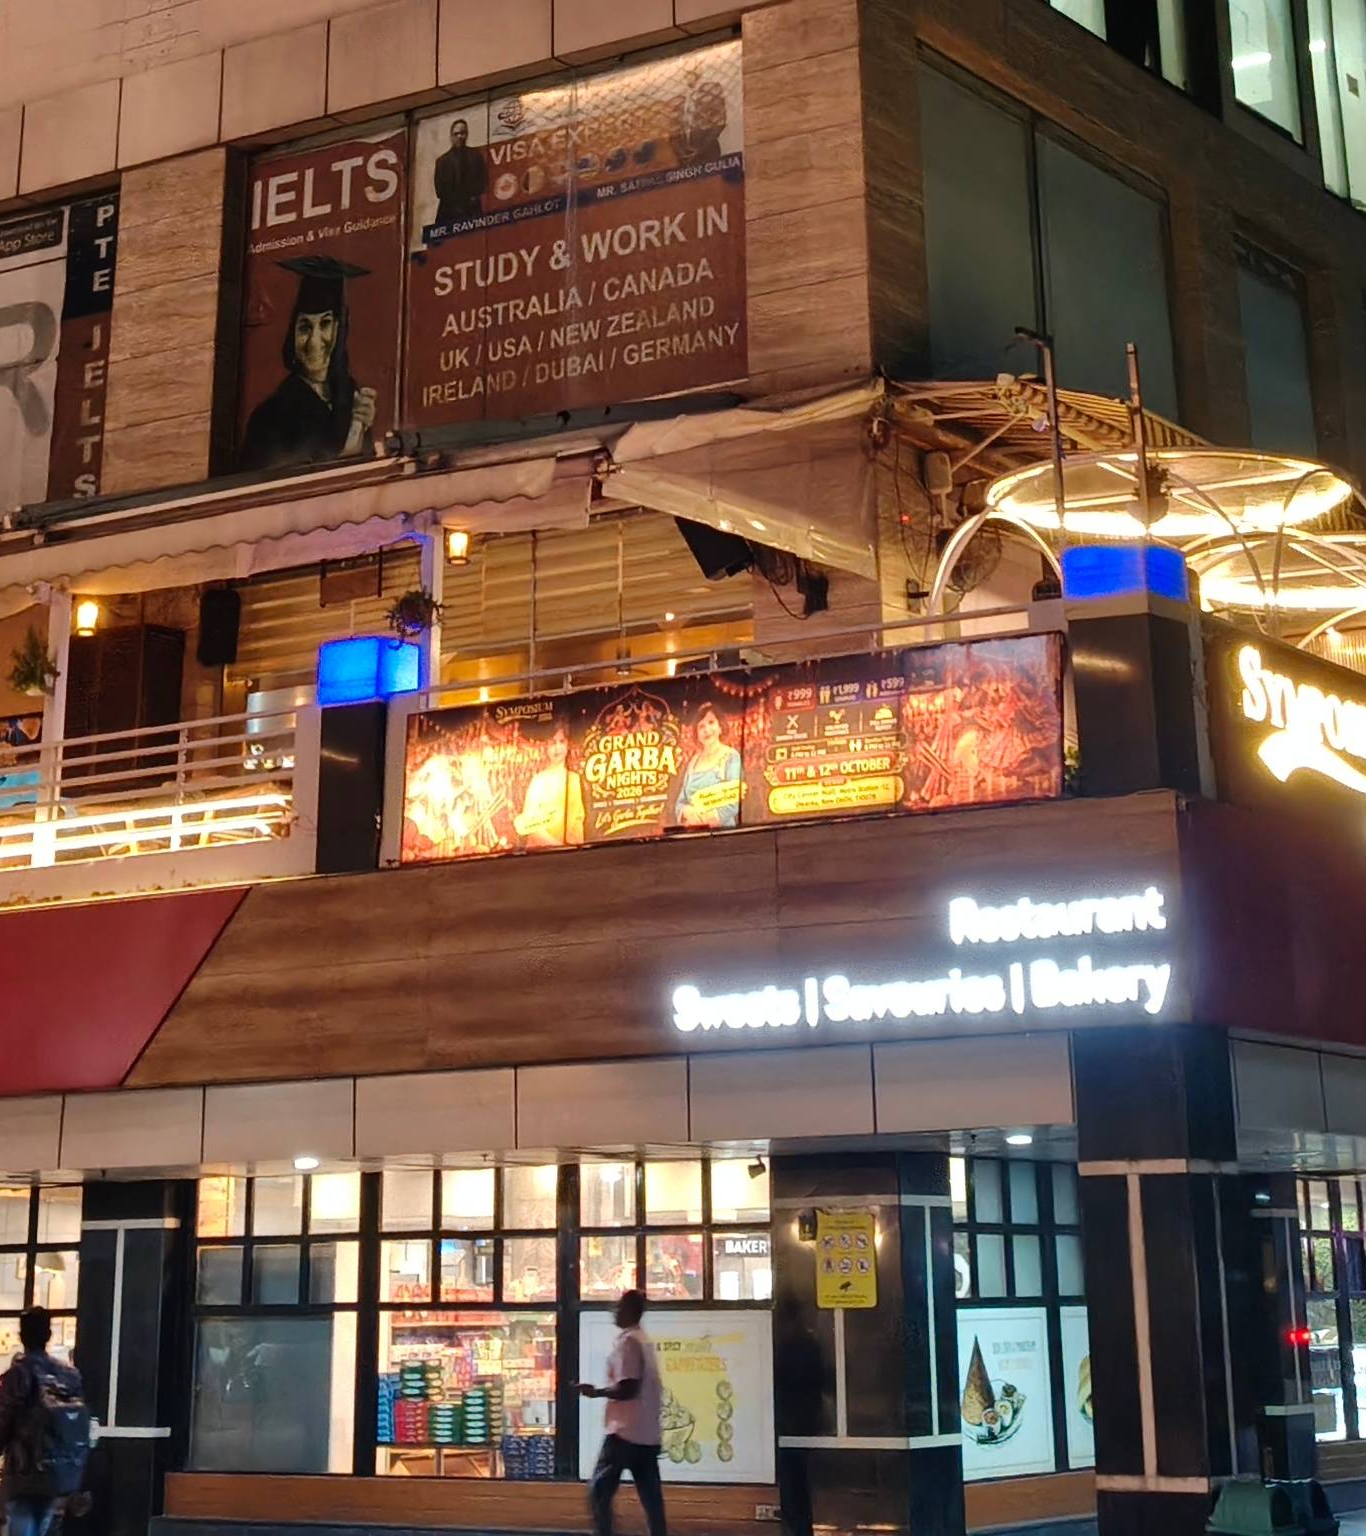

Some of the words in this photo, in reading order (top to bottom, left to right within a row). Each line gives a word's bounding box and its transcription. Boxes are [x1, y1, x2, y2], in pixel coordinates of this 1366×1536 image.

[251, 149, 398, 230] IELTS
[92, 204, 115, 293] PTE
[435, 240, 540, 296] STUDY
[549, 239, 571, 272] &
[582, 213, 687, 266] WORK
[697, 204, 730, 239] IN
[452, 211, 510, 233] RAVINDER
[442, 284, 583, 338] AUSTRALIA
[603, 258, 714, 303] CANADA
[440, 342, 473, 372] UK
[488, 330, 532, 362] USA
[550, 318, 602, 350] NEW
[607, 295, 715, 336] ZEALAND
[422, 368, 518, 408] IRELAND
[535, 348, 604, 385] DUBAI
[622, 323, 740, 366] GERMANY
[585, 746, 677, 783] GARBA
[599, 731, 660, 753] GRAND
[840, 757, 891, 775] OCTOBER
[606, 770, 657, 790] NIGHTS
[725, 1239, 768, 1254] BAKER
